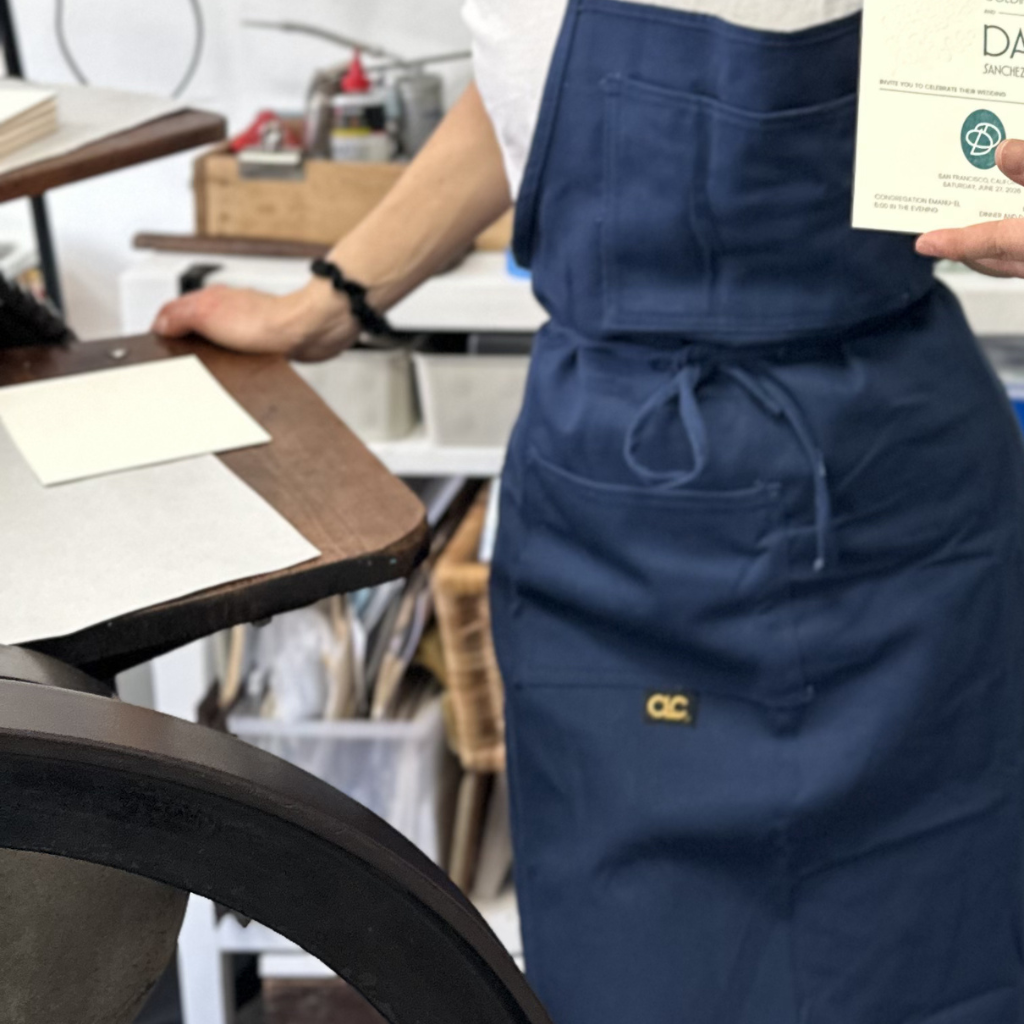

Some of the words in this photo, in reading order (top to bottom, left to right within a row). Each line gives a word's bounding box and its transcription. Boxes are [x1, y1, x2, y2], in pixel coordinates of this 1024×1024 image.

[984, 8, 996, 16] AND
[879, 79, 898, 87] INVITE
[925, 84, 957, 93] CELEBRATE
[977, 89, 1006, 97] WEDDING
[978, 184, 993, 192] JUNE
[874, 193, 927, 204] CONGREGATION
[911, 205, 938, 213] EVENING
[979, 211, 1002, 219] DINNER
